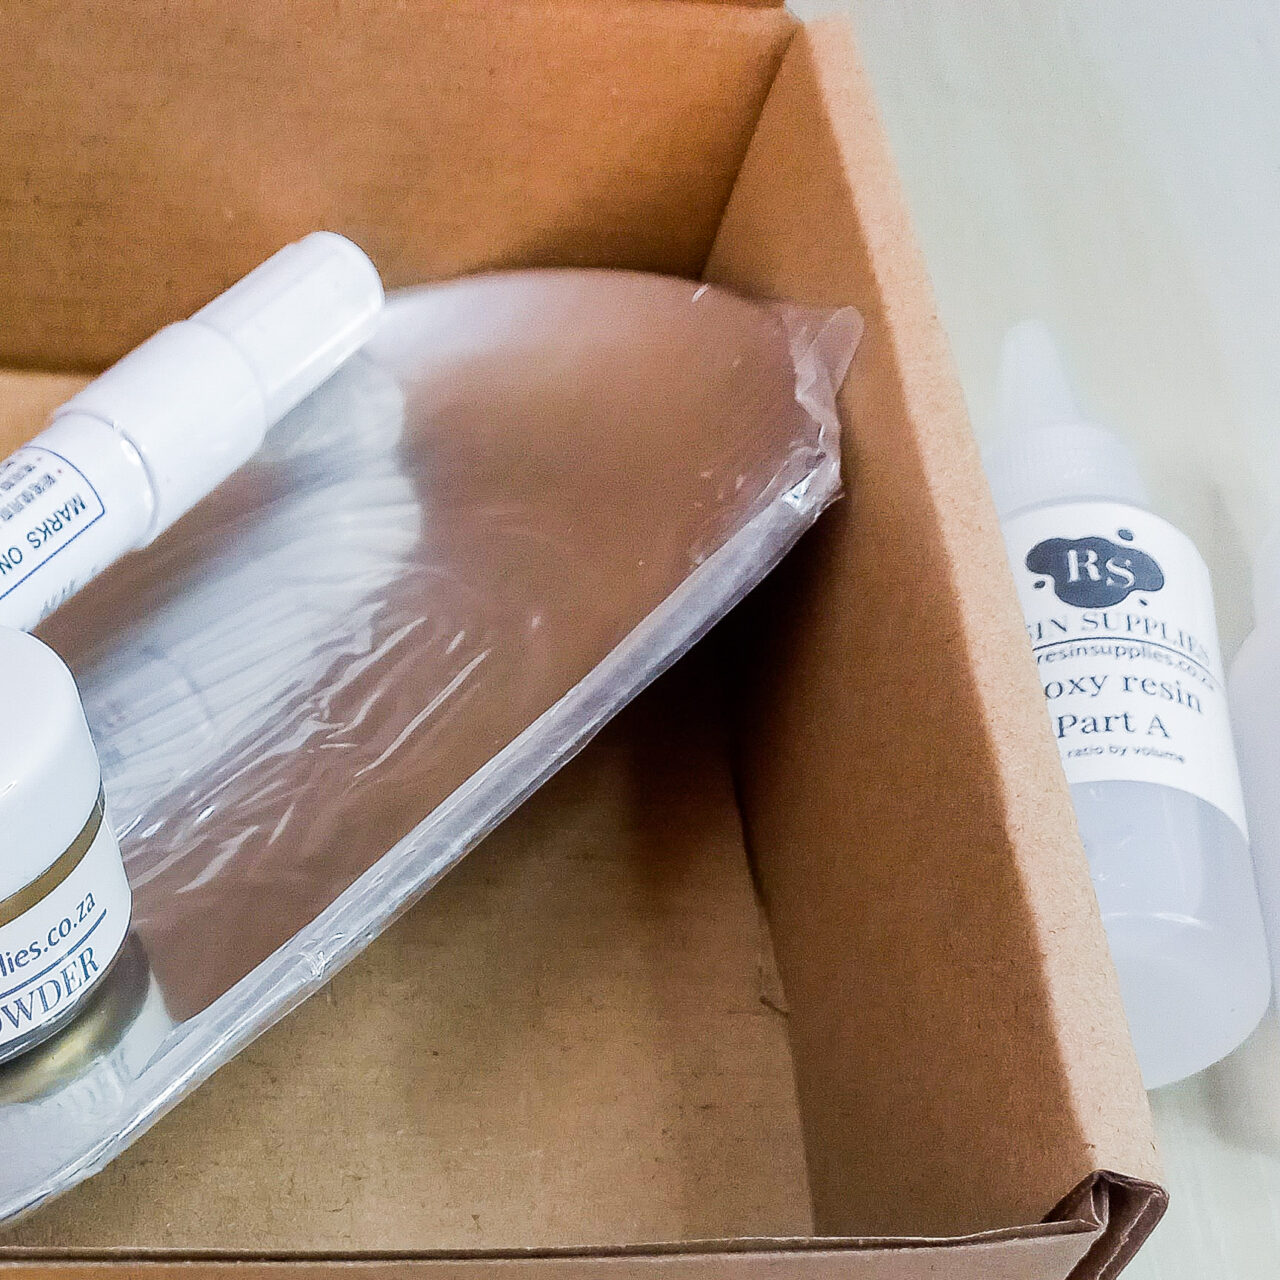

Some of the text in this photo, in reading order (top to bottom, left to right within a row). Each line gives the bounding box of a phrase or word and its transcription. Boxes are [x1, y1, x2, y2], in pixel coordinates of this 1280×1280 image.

[26, 493, 87, 550] MARKS
[0, 546, 24, 575] ON
[1123, 676, 1203, 714] resin
[1057, 713, 1171, 739] Part A
[1109, 746, 1127, 757] by
